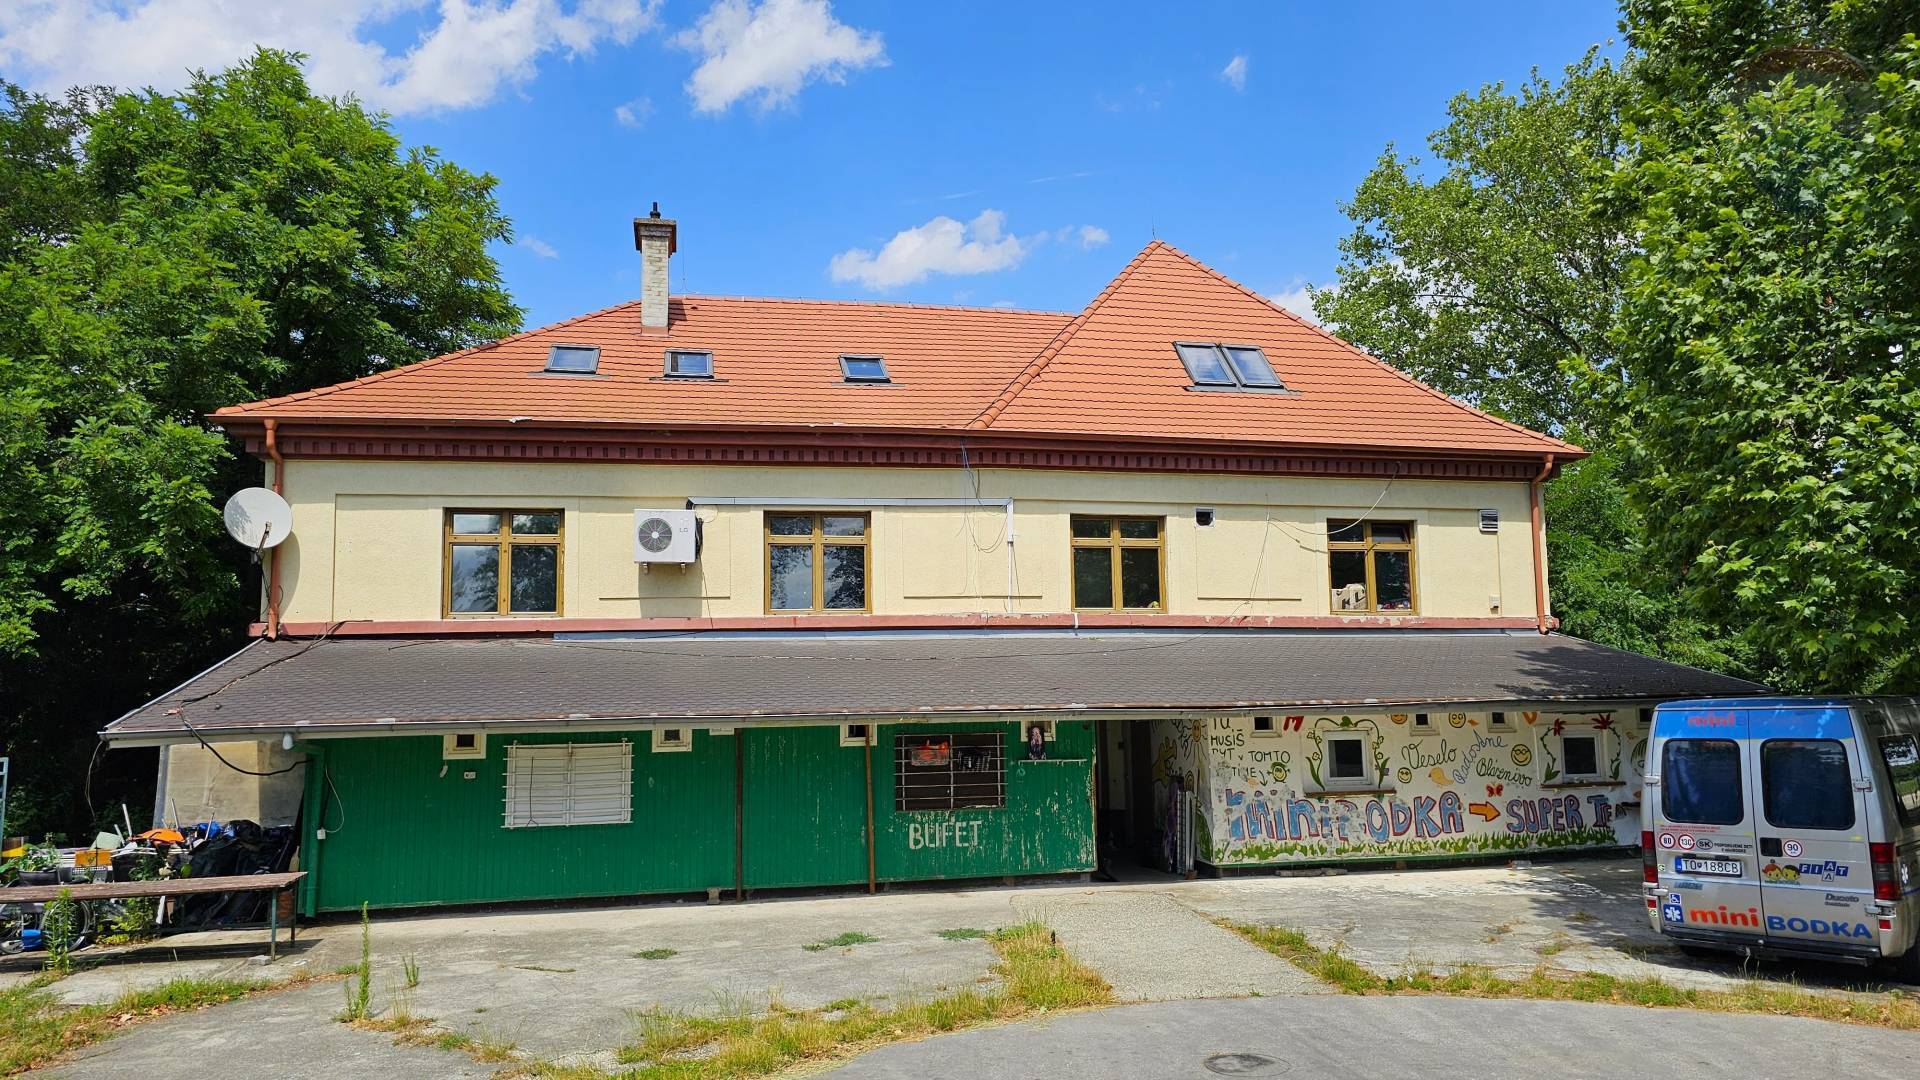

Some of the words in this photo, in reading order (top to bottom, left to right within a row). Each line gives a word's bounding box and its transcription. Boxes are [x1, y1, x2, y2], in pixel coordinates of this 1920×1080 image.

[1687, 711, 1736, 727] mini
[1248, 750, 1291, 764] TOMTO
[1402, 739, 1457, 769] Veselo
[1506, 794, 1584, 834] SUPER
[908, 819, 982, 850] BUFET
[1681, 838, 1692, 846] 130
[1699, 840, 1711, 848] SK
[1787, 843, 1799, 852] 90
[1683, 860, 1697, 871] TO
[1704, 861, 1739, 874] 188CB
[1801, 862, 1846, 875] FIAT
[1825, 893, 1860, 903] Ducato
[1690, 905, 1759, 927] mini
[1766, 915, 1873, 939] BODKA
